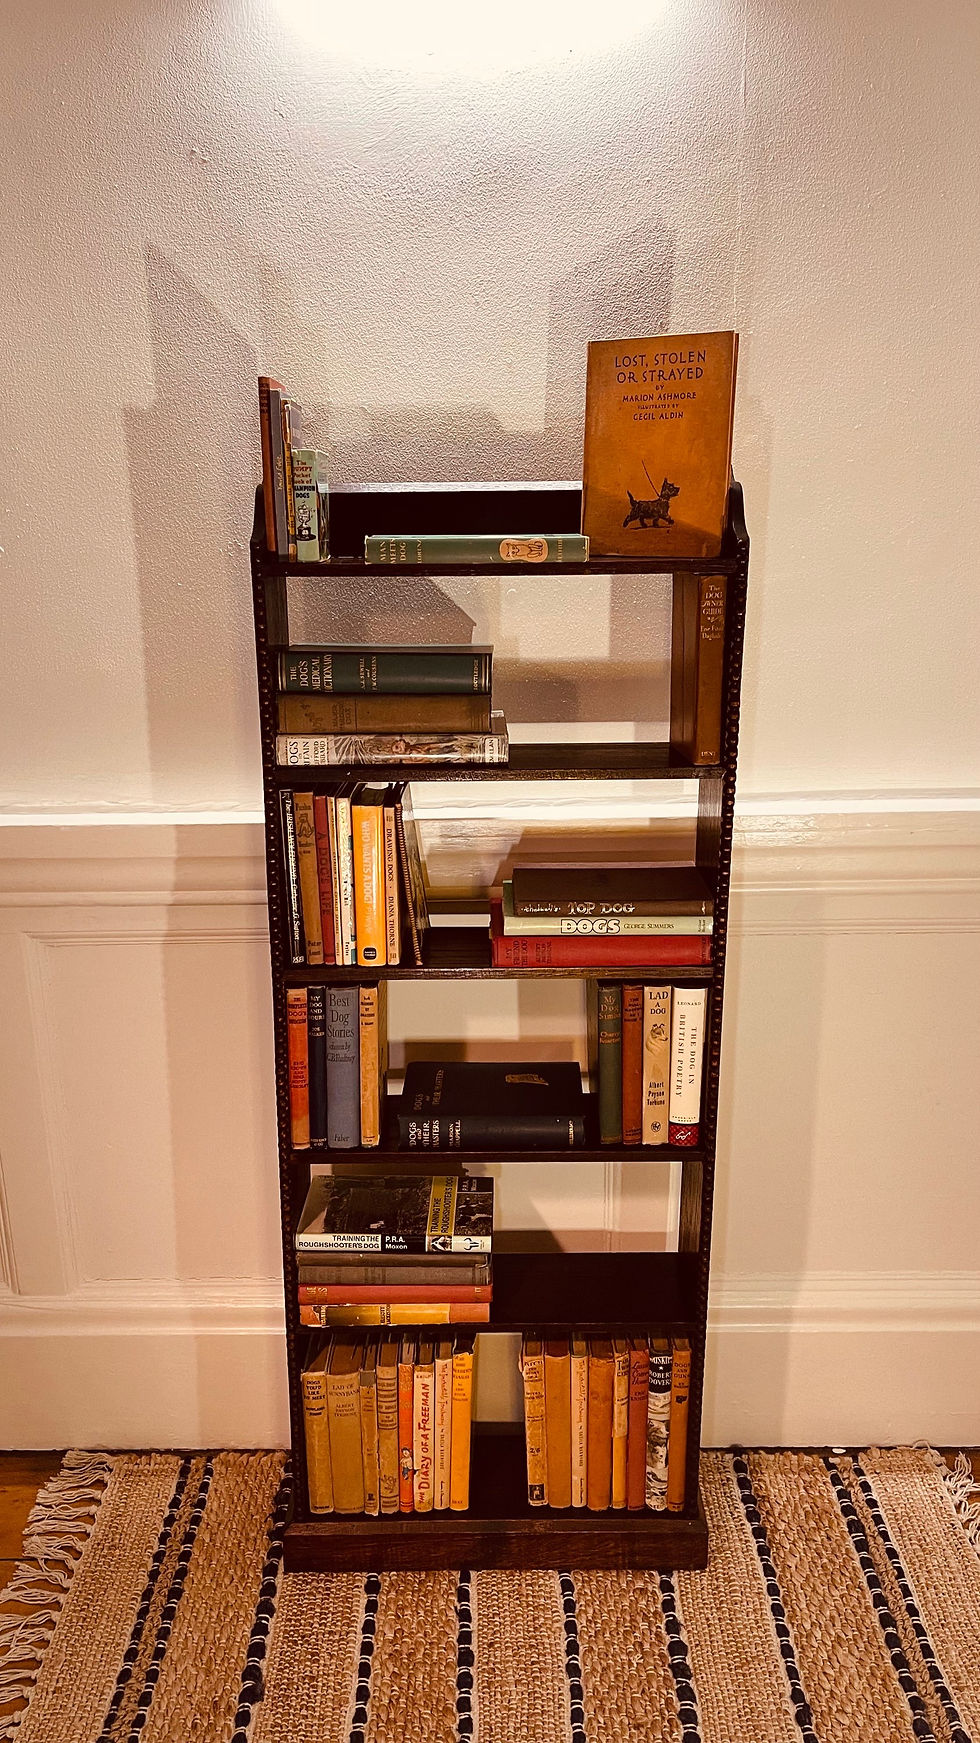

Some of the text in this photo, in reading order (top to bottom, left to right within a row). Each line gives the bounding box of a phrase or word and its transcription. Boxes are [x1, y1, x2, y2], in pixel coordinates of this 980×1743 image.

[615, 350, 706, 368] LOST, STOLEN
[617, 367, 704, 384] OR STRAYED
[622, 392, 697, 402] MARION ASHMORE
[633, 411, 684, 421] CECIL ALDIN
[300, 660, 309, 687] DOG'S
[311, 656, 321, 691] MEDICAL
[289, 741, 299, 764] OGS
[286, 812, 294, 833] IRISH
[361, 821, 371, 842] WHO
[386, 828, 394, 862] DRAWING
[362, 843, 372, 873] WANTS
[322, 891, 332, 916] LIFE
[567, 901, 635, 915] TOP DOG
[560, 918, 620, 934] DOGS
[329, 994, 350, 1006] Best
[649, 991, 669, 1000] LAD
[331, 1010, 350, 1025] Dog
[327, 1027, 354, 1038] Stories
[675, 1014, 686, 1098] BRITISH POETRY
[688, 1027, 698, 1085] THE DOG IN
[648, 1090, 665, 1099] Payson
[409, 1121, 417, 1147] DOGS
[431, 1197, 442, 1233] TRAINING THE
[418, 1383, 431, 1432] FREEMAN
[421, 1441, 429, 1453] OF
[418, 1456, 431, 1490] DIARY
